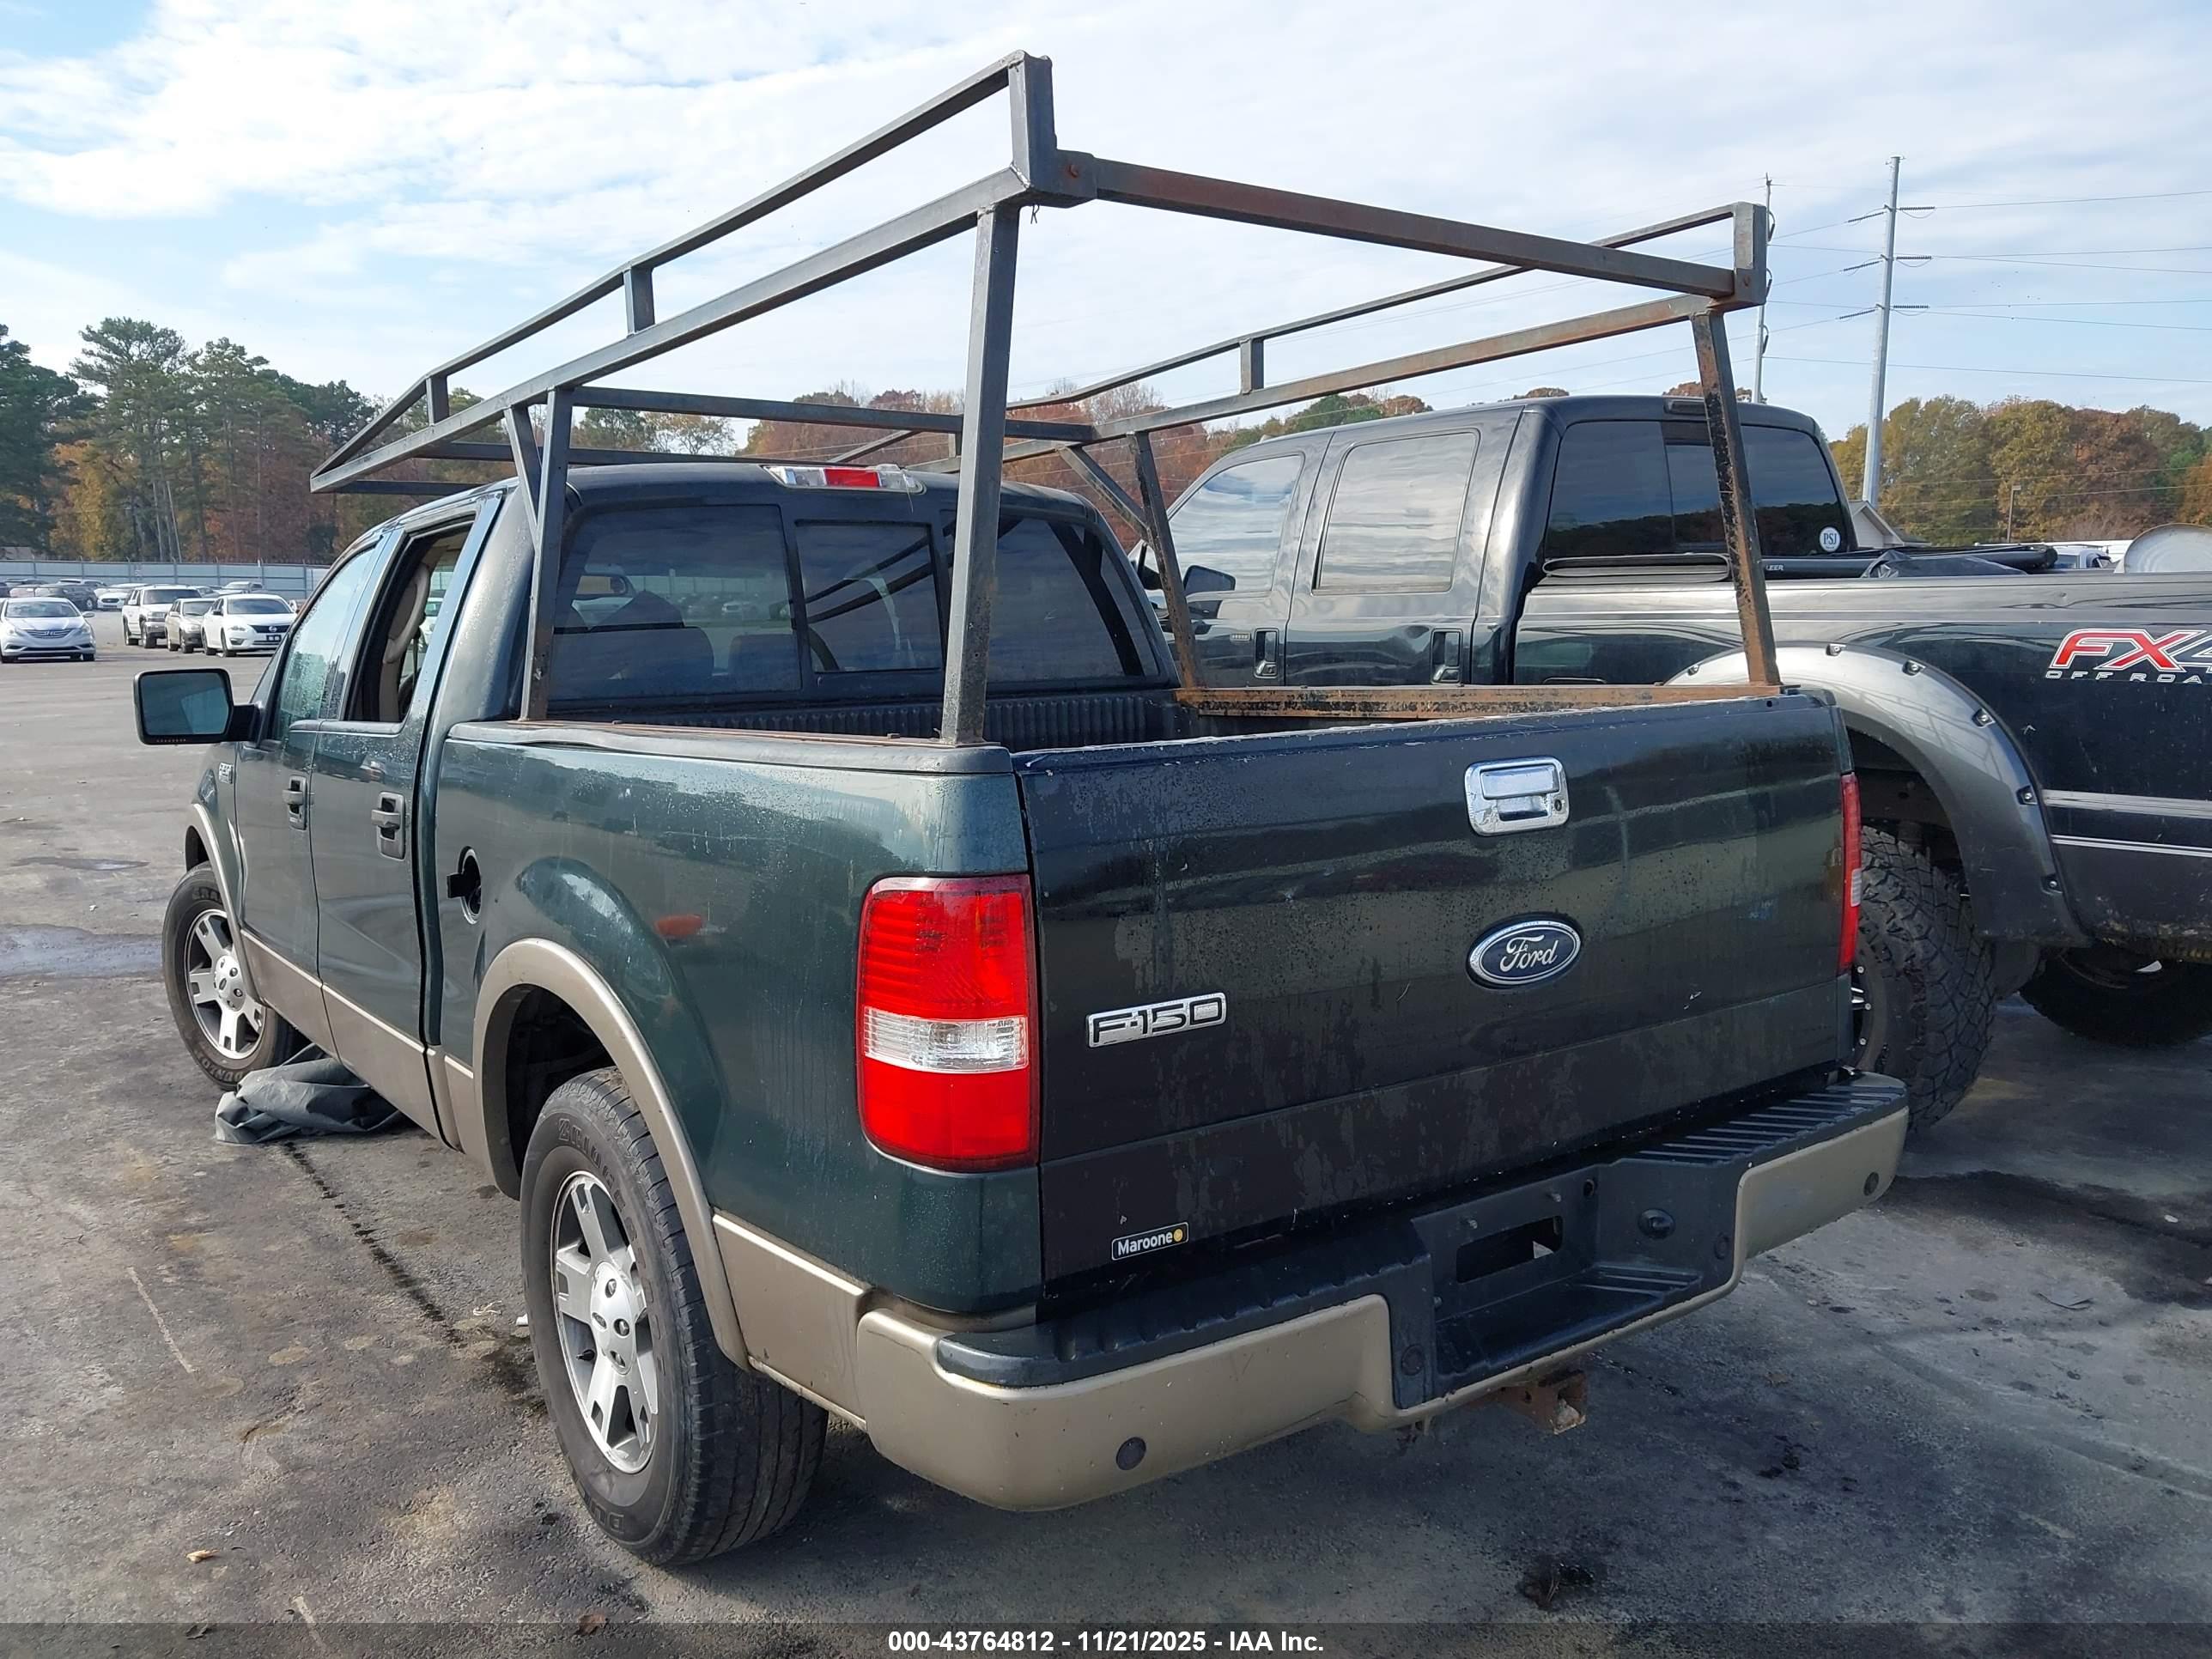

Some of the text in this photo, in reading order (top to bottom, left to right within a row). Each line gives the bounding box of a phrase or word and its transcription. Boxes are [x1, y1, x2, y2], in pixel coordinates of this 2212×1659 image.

[2045, 670, 2203, 684] OFF ROA
[1499, 934, 1559, 972] Ford
[1091, 995, 1224, 1045] F-150
[1117, 1231, 1174, 1256] Maroone
